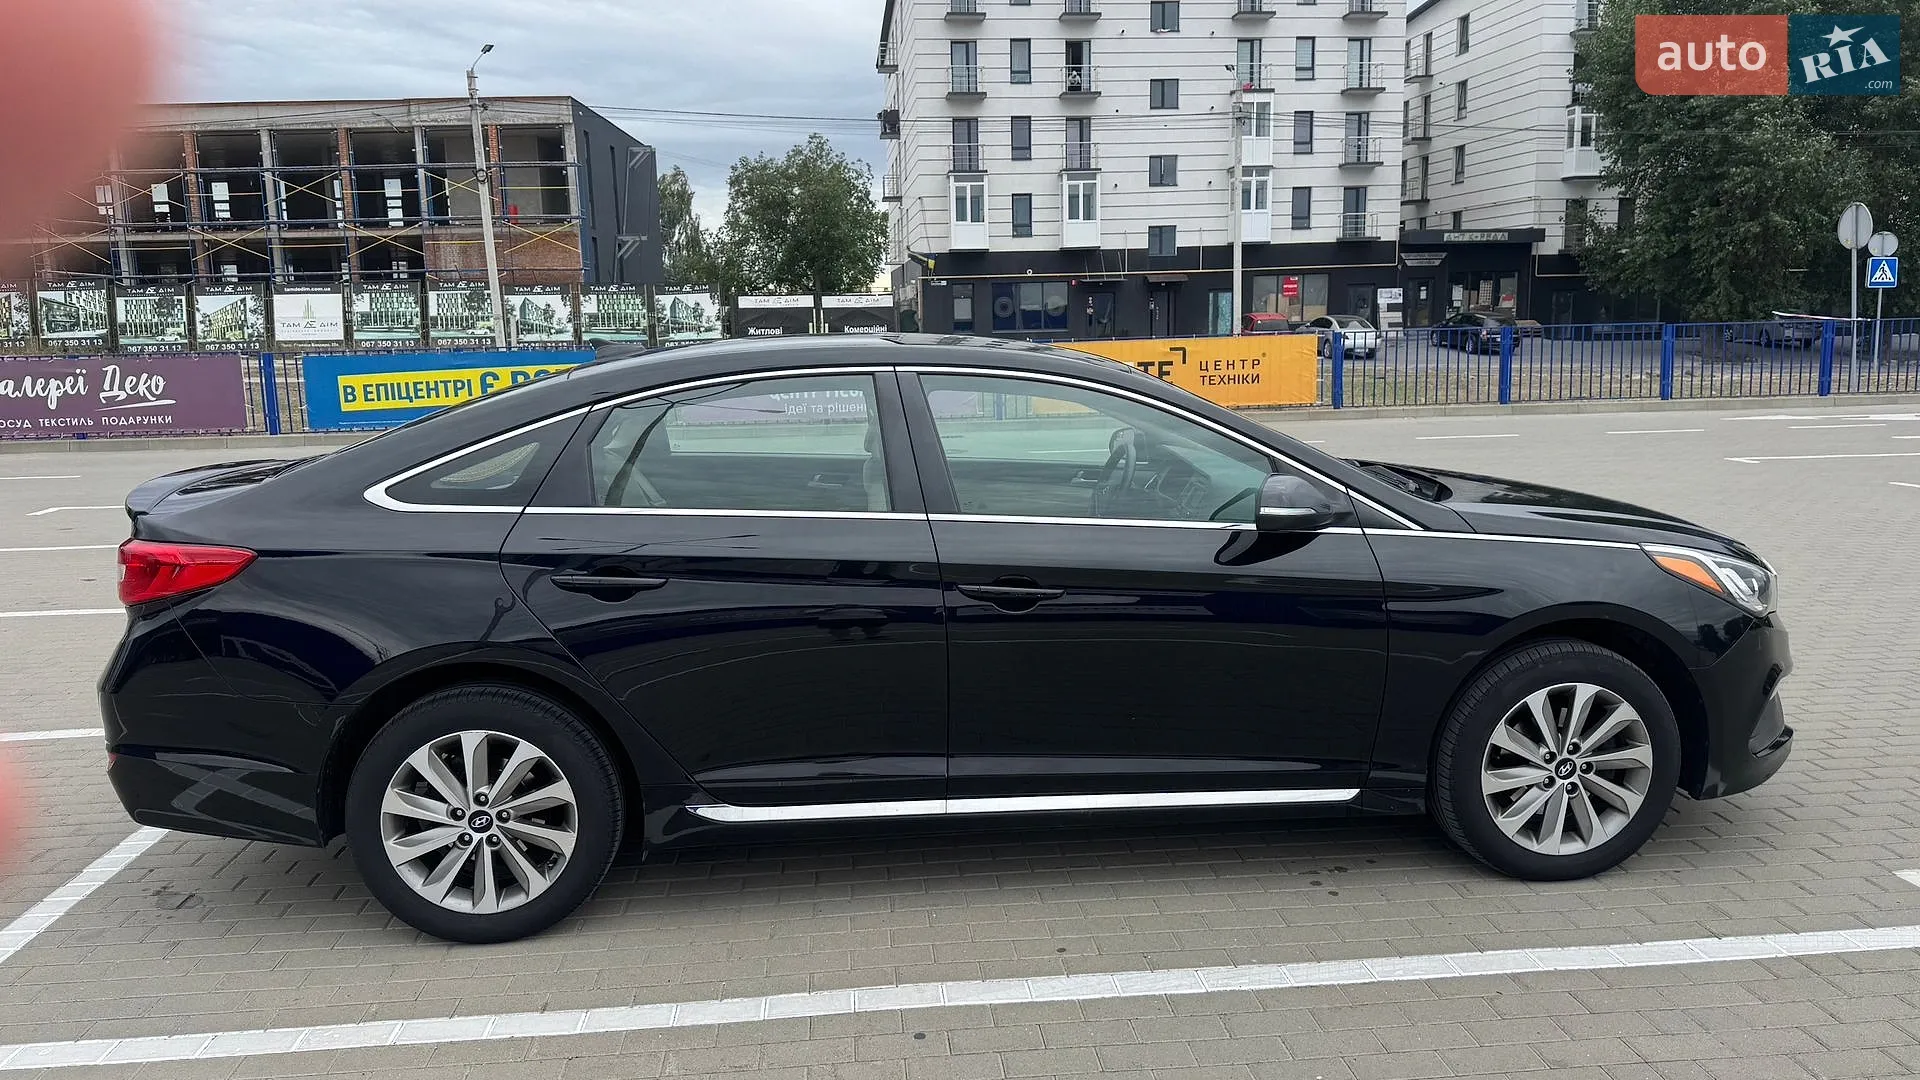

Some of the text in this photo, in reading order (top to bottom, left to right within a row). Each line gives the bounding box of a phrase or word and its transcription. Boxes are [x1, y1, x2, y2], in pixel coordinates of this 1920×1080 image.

[747, 326, 783, 335] Житлові
[1199, 358, 1261, 372] ЦЕНТР
[99, 365, 166, 403] Деко
[1200, 373, 1260, 386] ТЕХНІКИ
[342, 384, 356, 403] В
[362, 379, 473, 403] ЕПІЦЕНТРІ
[480, 371, 500, 394] Є
[784, 403, 807, 415] ідеї
[810, 404, 824, 413] та
[39, 417, 94, 427] ТЕКСТИЛЬ
[102, 415, 173, 426] ПОДАРУНКИ
